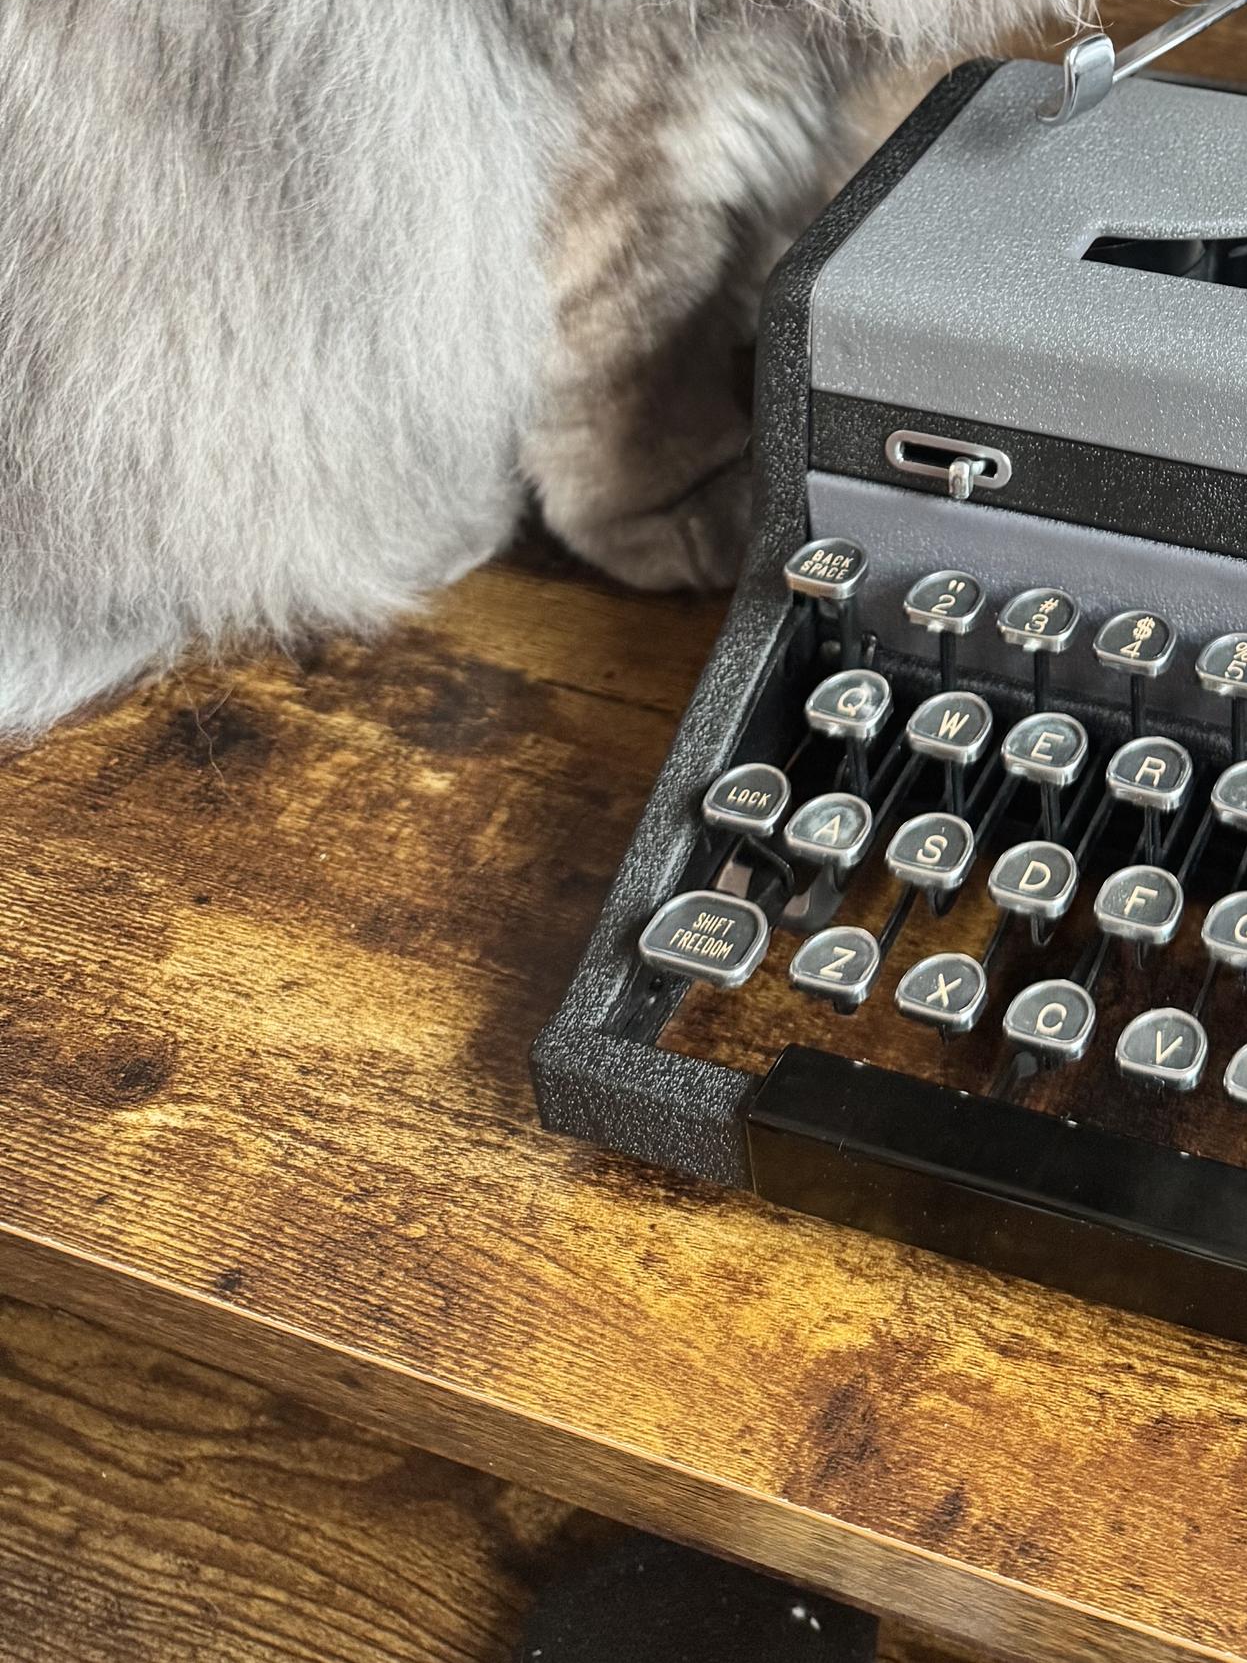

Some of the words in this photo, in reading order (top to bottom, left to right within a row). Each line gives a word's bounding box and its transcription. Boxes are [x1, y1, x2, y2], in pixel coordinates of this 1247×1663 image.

[800, 560, 849, 580] SPACE
[812, 549, 854, 569] BACK
[930, 594, 956, 615] 2
[1025, 614, 1049, 634] 3
[1133, 616, 1155, 640] $
[1120, 640, 1141, 659] 4
[1224, 661, 1245, 681] 5
[838, 686, 867, 717] Q
[937, 709, 970, 739] W
[1030, 732, 1064, 761] E
[1134, 756, 1167, 787] R
[727, 786, 772, 809] LOCK
[814, 815, 841, 845] A
[916, 835, 948, 865] S
[1019, 860, 1051, 891] D
[1123, 885, 1158, 915] F
[692, 912, 735, 938] SHIFT
[669, 928, 734, 961] FREEDOM
[819, 946, 857, 979] Z
[926, 973, 962, 1008] X
[1034, 1003, 1066, 1034] C
[1155, 1030, 1183, 1065] V
